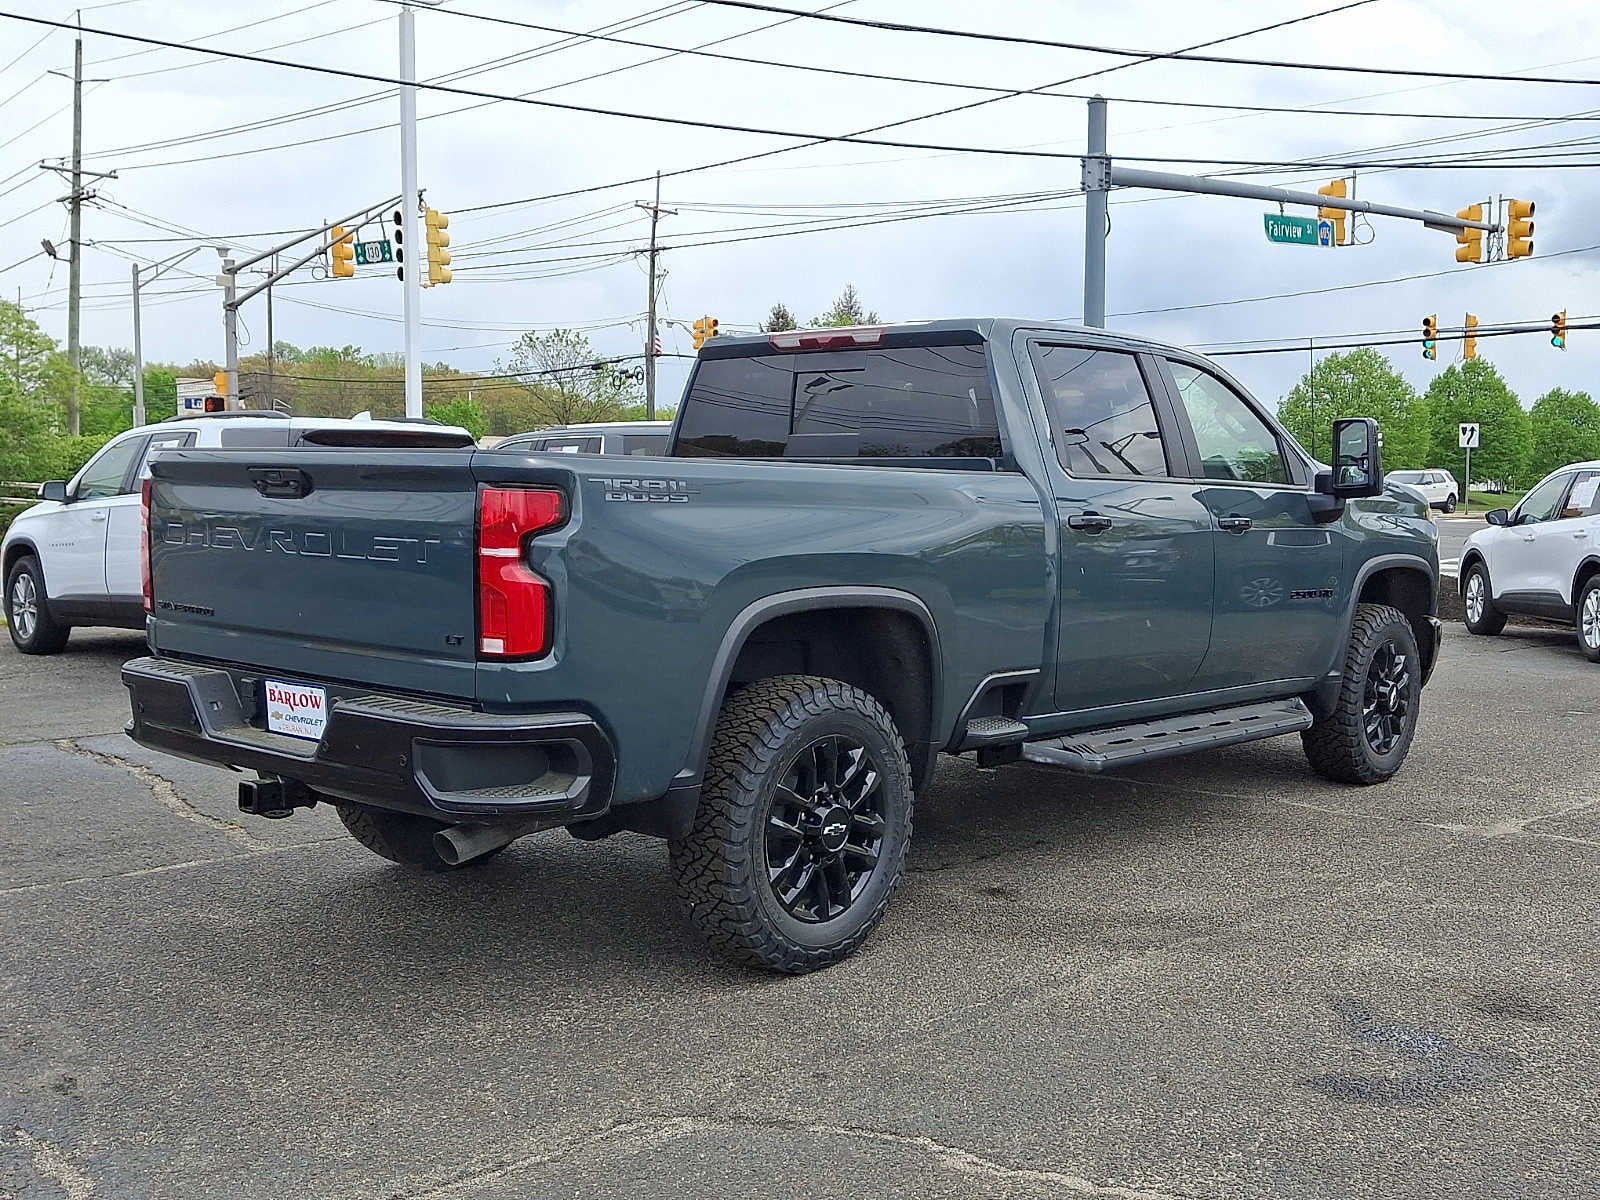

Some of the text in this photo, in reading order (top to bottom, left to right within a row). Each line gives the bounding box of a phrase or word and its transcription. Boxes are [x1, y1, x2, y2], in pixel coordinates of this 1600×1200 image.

[1268, 220, 1313, 238] Fairview St
[367, 246, 380, 259] 130
[605, 494, 689, 503] BOSS
[162, 522, 441, 564] CHEVROLET
[446, 634, 465, 646] LT
[269, 688, 322, 712] BARLOW
[284, 713, 323, 726] CHEVROLET
